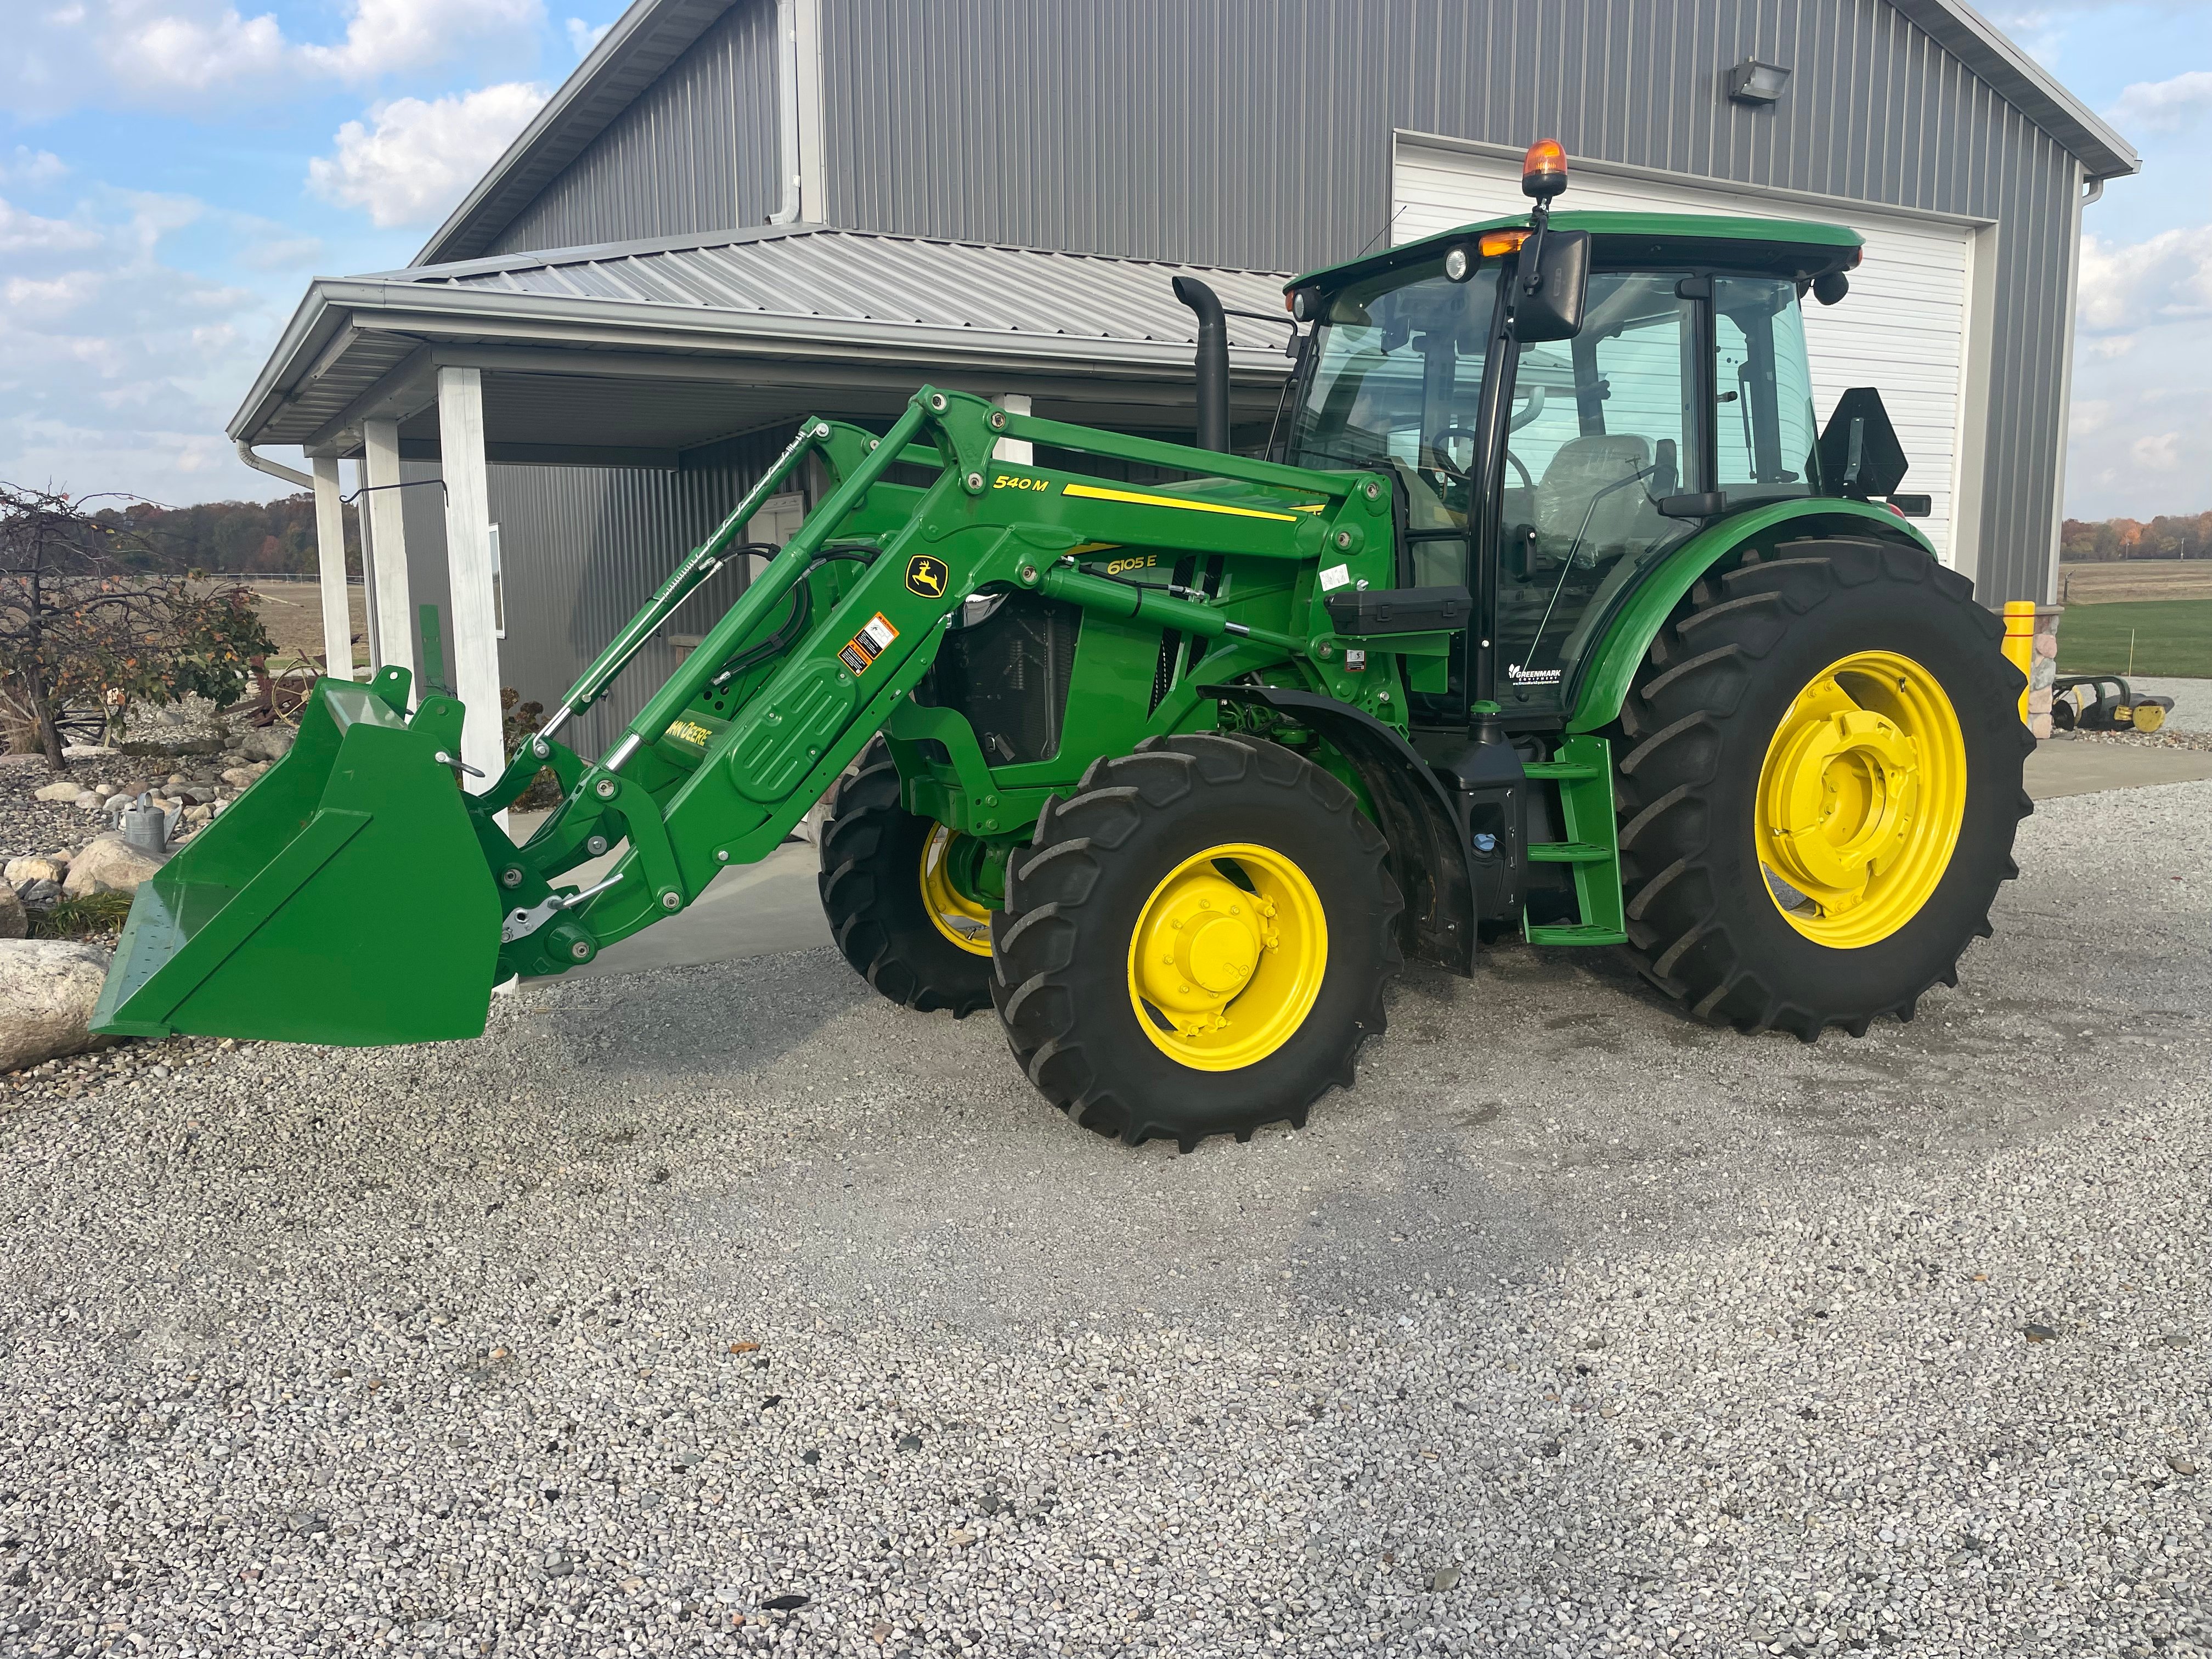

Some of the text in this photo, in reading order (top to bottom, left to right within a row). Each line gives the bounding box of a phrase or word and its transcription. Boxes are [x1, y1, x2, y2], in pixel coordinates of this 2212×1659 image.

[992, 475, 1050, 492] 540 M
[1107, 554, 1157, 575] 6105 E
[1515, 669, 1562, 679] GREENMARK
[680, 721, 713, 747] DEERE
